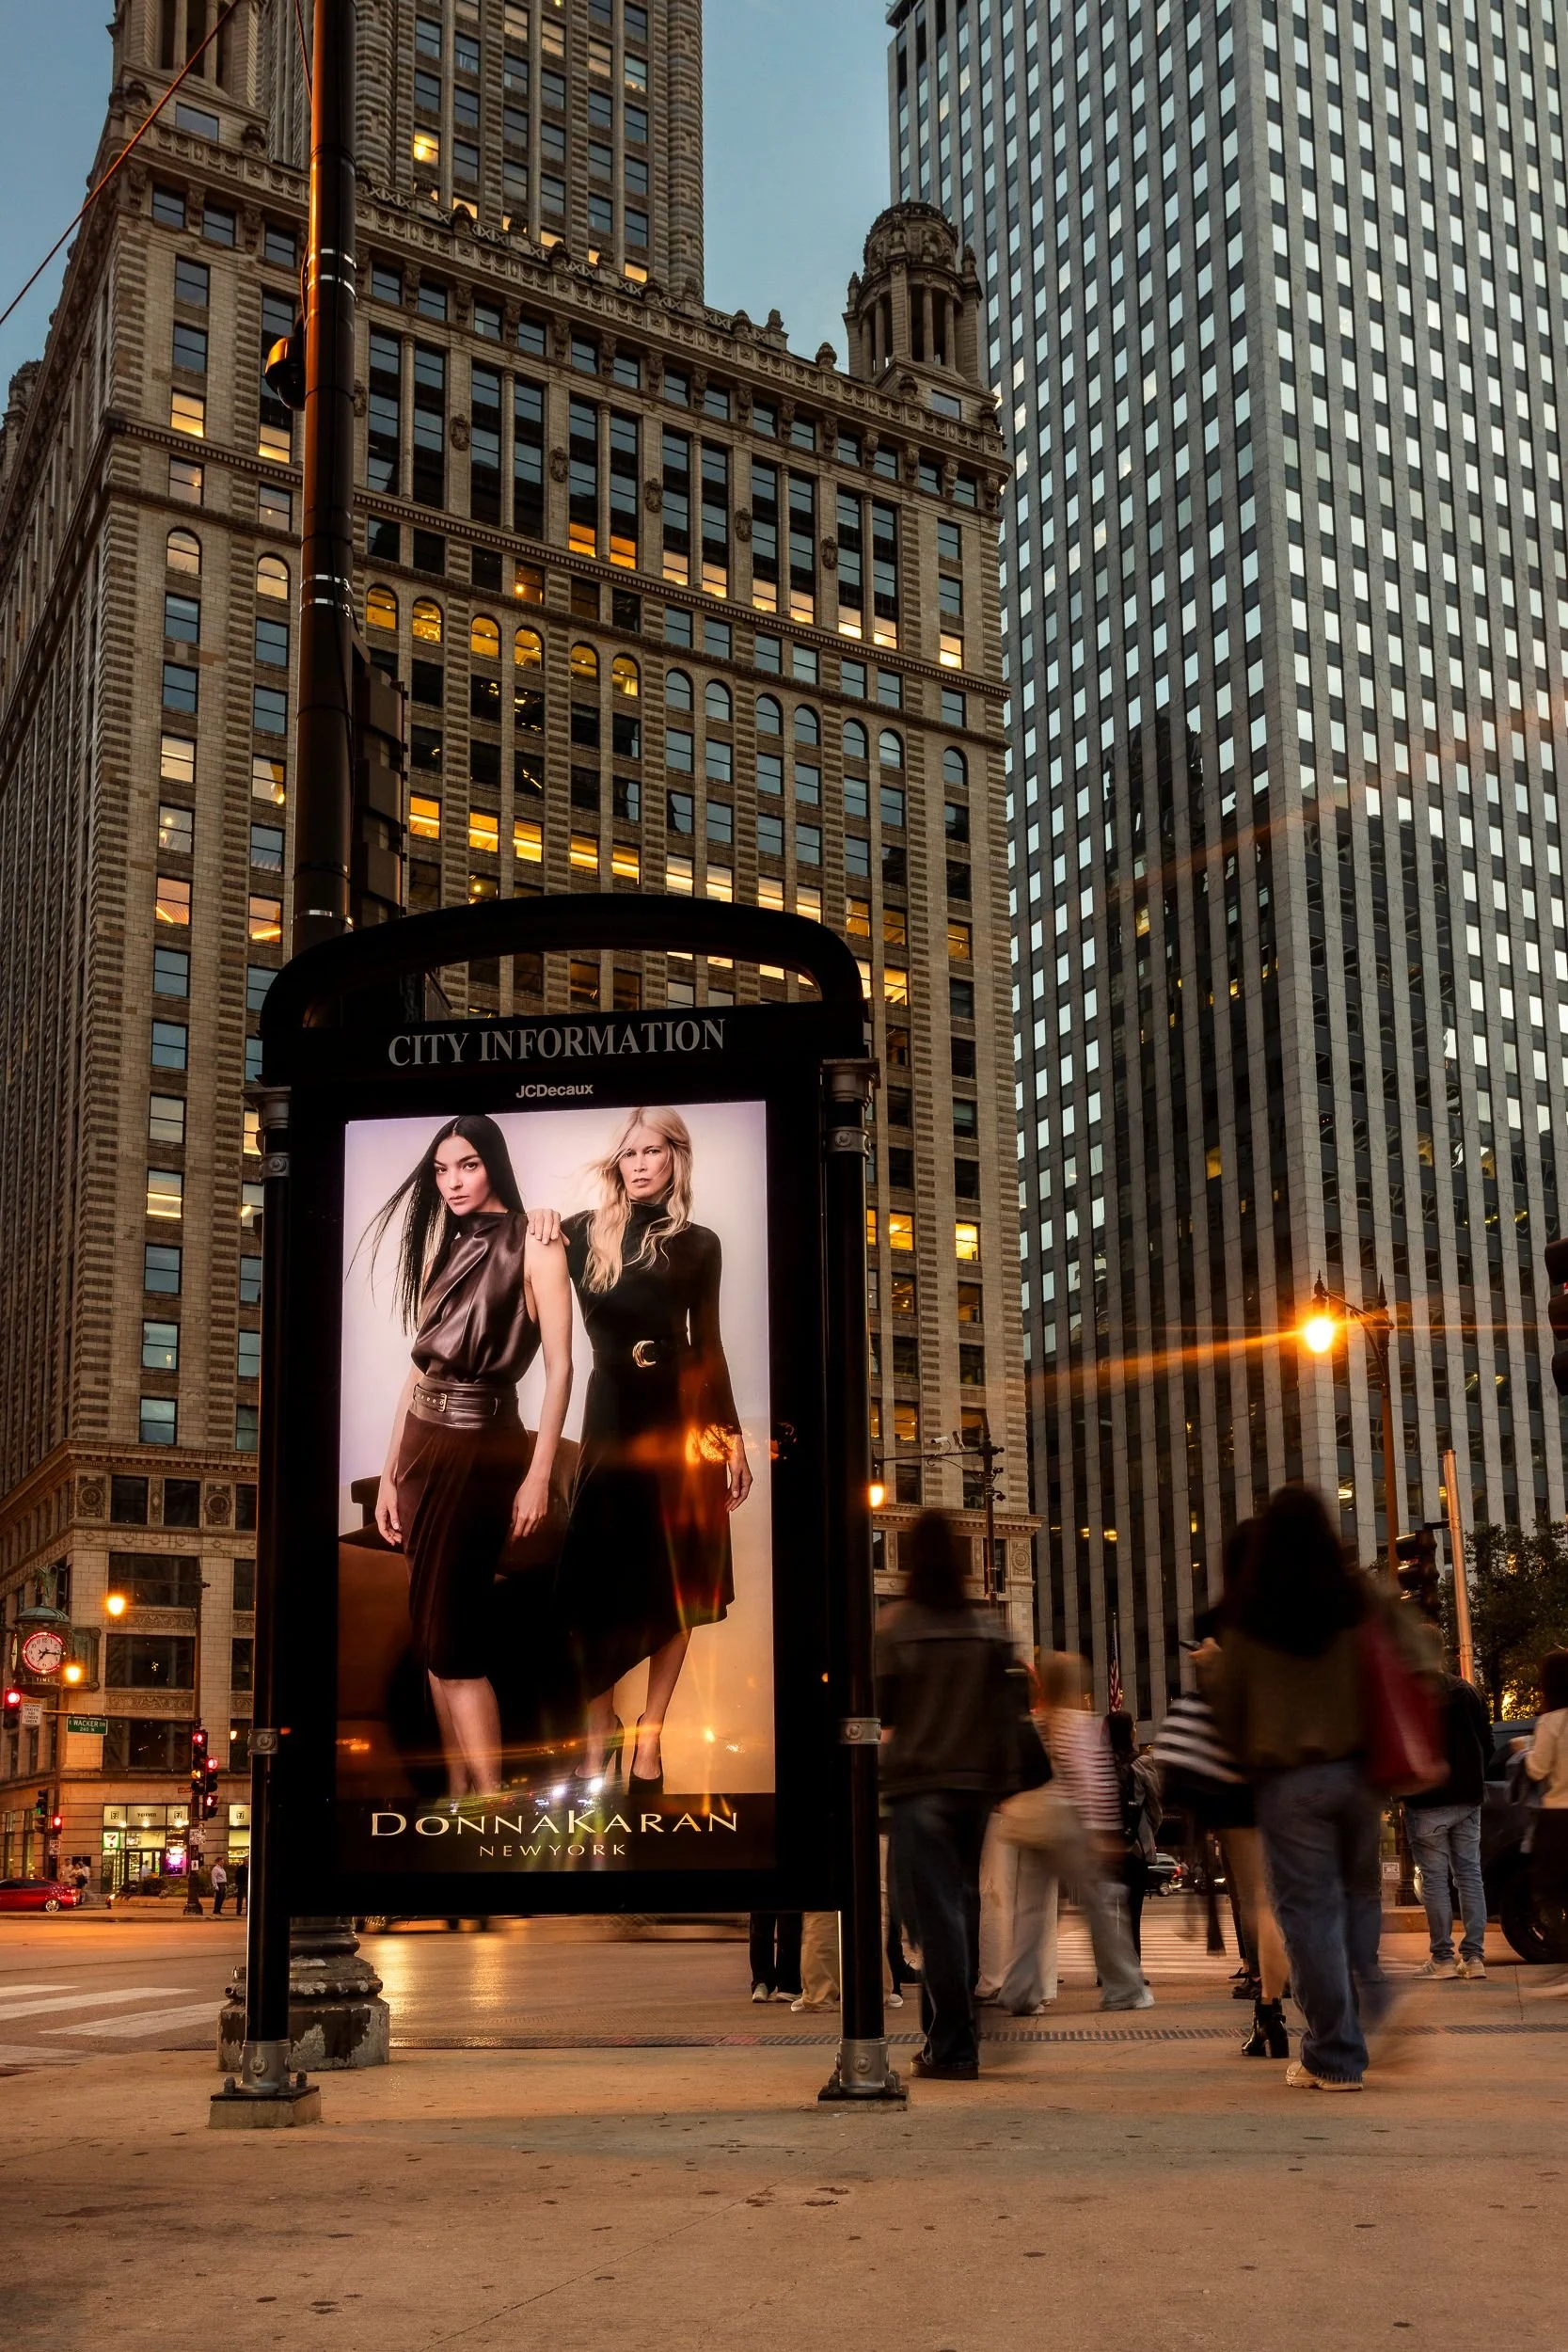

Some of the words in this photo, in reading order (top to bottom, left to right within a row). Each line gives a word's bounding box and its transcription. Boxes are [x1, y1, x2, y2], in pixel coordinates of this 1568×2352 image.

[388, 1032, 468, 1067] CITY
[479, 1019, 725, 1062] INFORMATION
[515, 1084, 594, 1099] JCDecaux
[73, 1719, 99, 1728] WACKER
